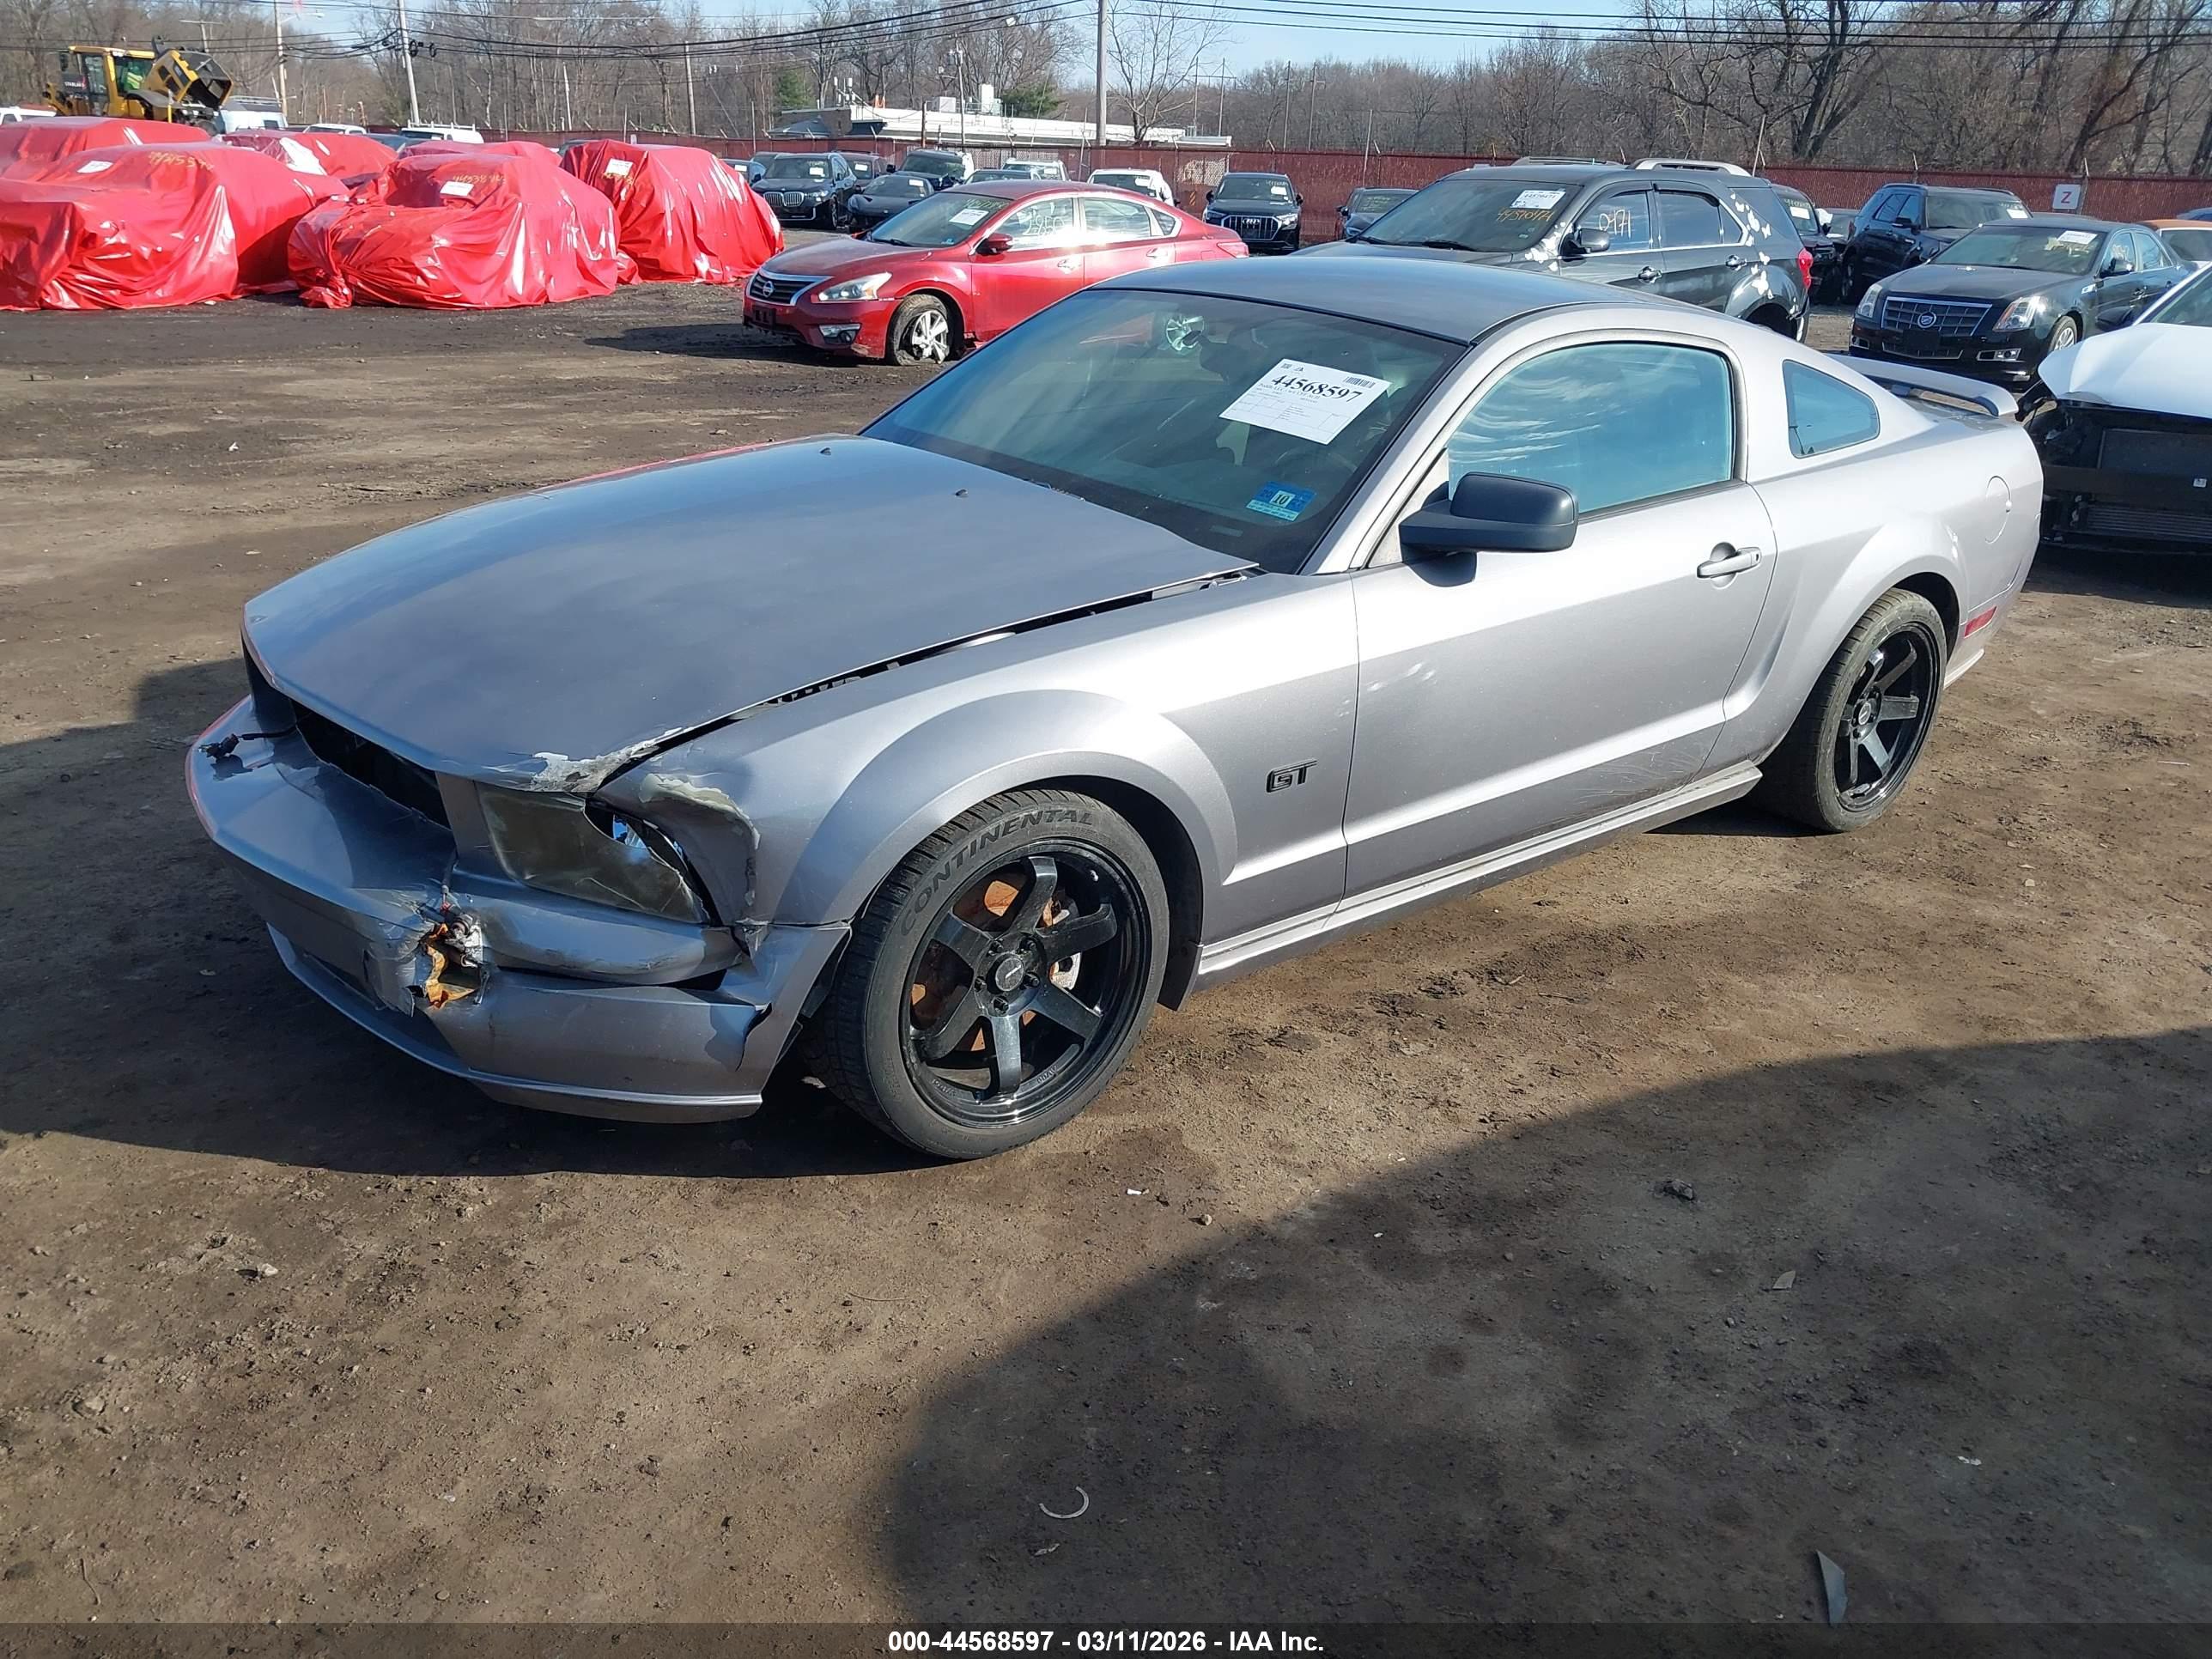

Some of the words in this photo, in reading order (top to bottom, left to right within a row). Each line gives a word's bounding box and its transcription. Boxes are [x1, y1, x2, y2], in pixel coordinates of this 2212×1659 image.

[2061, 191, 2072, 204] Z
[1271, 374, 1364, 402] 44568597
[1273, 494, 1291, 505] 10
[1267, 760, 1317, 793] GT
[902, 810, 1093, 936] CONTINENTAL
